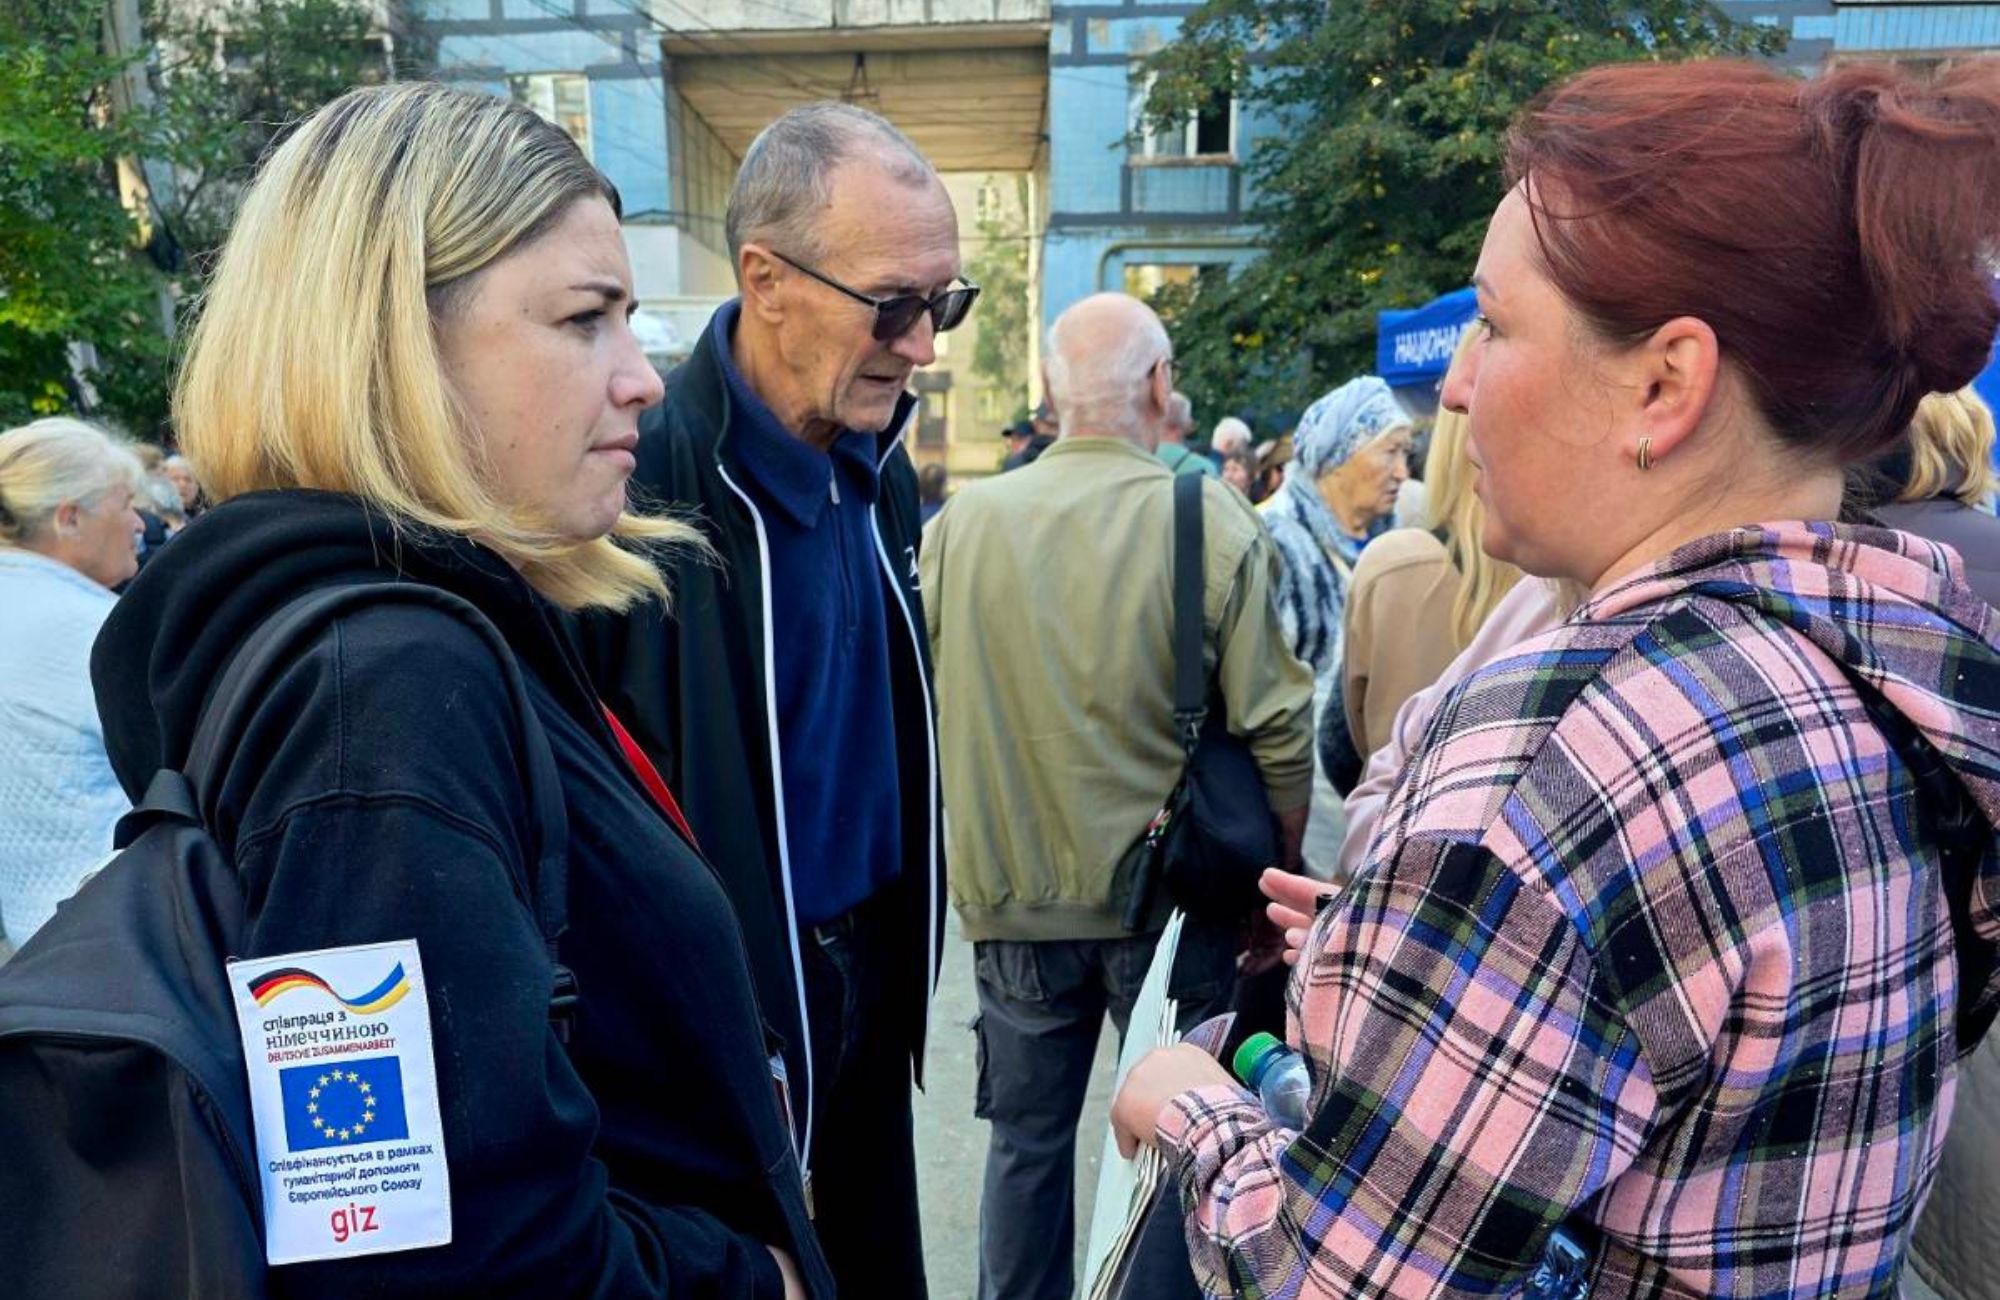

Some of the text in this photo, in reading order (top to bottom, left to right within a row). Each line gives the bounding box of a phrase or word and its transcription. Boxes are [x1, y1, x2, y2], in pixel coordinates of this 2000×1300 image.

[338, 1010, 347, 1022] з
[268, 1038, 395, 1063] DEUTSCHE ZUSAMMENARBEIT
[269, 1144, 434, 1173] Співфінансується в рамках
[283, 1162, 420, 1188] гуманітарної допомоги
[288, 1178, 422, 1203] Європейського Союзу
[331, 1202, 379, 1243] giz
